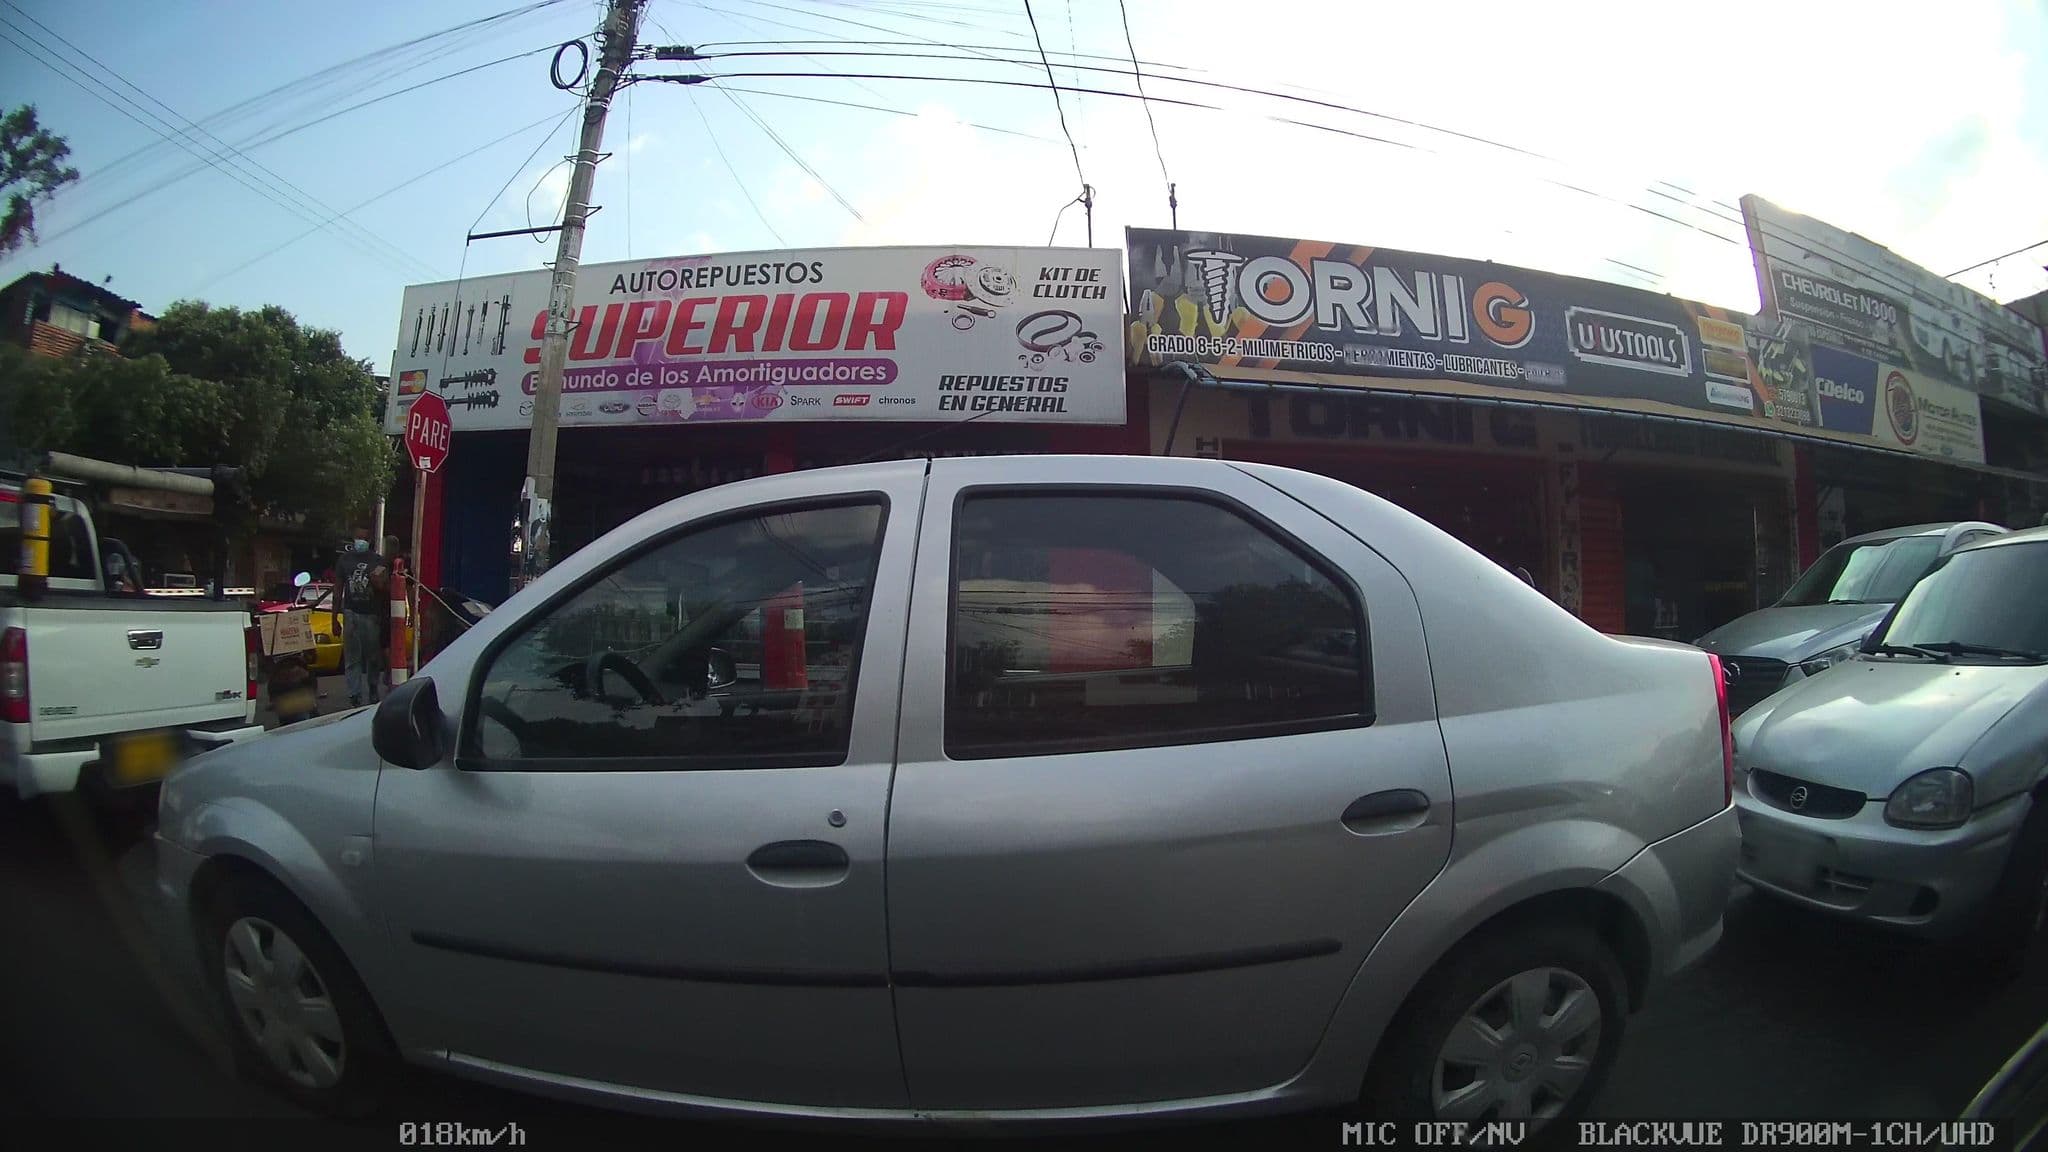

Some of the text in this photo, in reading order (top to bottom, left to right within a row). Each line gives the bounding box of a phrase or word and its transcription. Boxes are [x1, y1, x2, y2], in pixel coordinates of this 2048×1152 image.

[610, 261, 823, 295] AUTOREPUESTOS
[1040, 267, 1101, 281] KIT DE
[1033, 284, 1106, 299] CLUTCH
[1782, 271, 1897, 326] CHEVROLET N300
[1148, 335, 1194, 354] GRADO
[1444, 354, 1517, 378] LUBRICANTES
[625, 367, 653, 387] de
[660, 365, 688, 385] los
[696, 360, 887, 386] Amortiguadores
[939, 376, 1068, 393] REPUESTOS
[834, 396, 869, 406] SWIFT
[878, 396, 916, 406] chronos
[939, 395, 1068, 413] EN GENERAL
[411, 412, 448, 452] PARE
